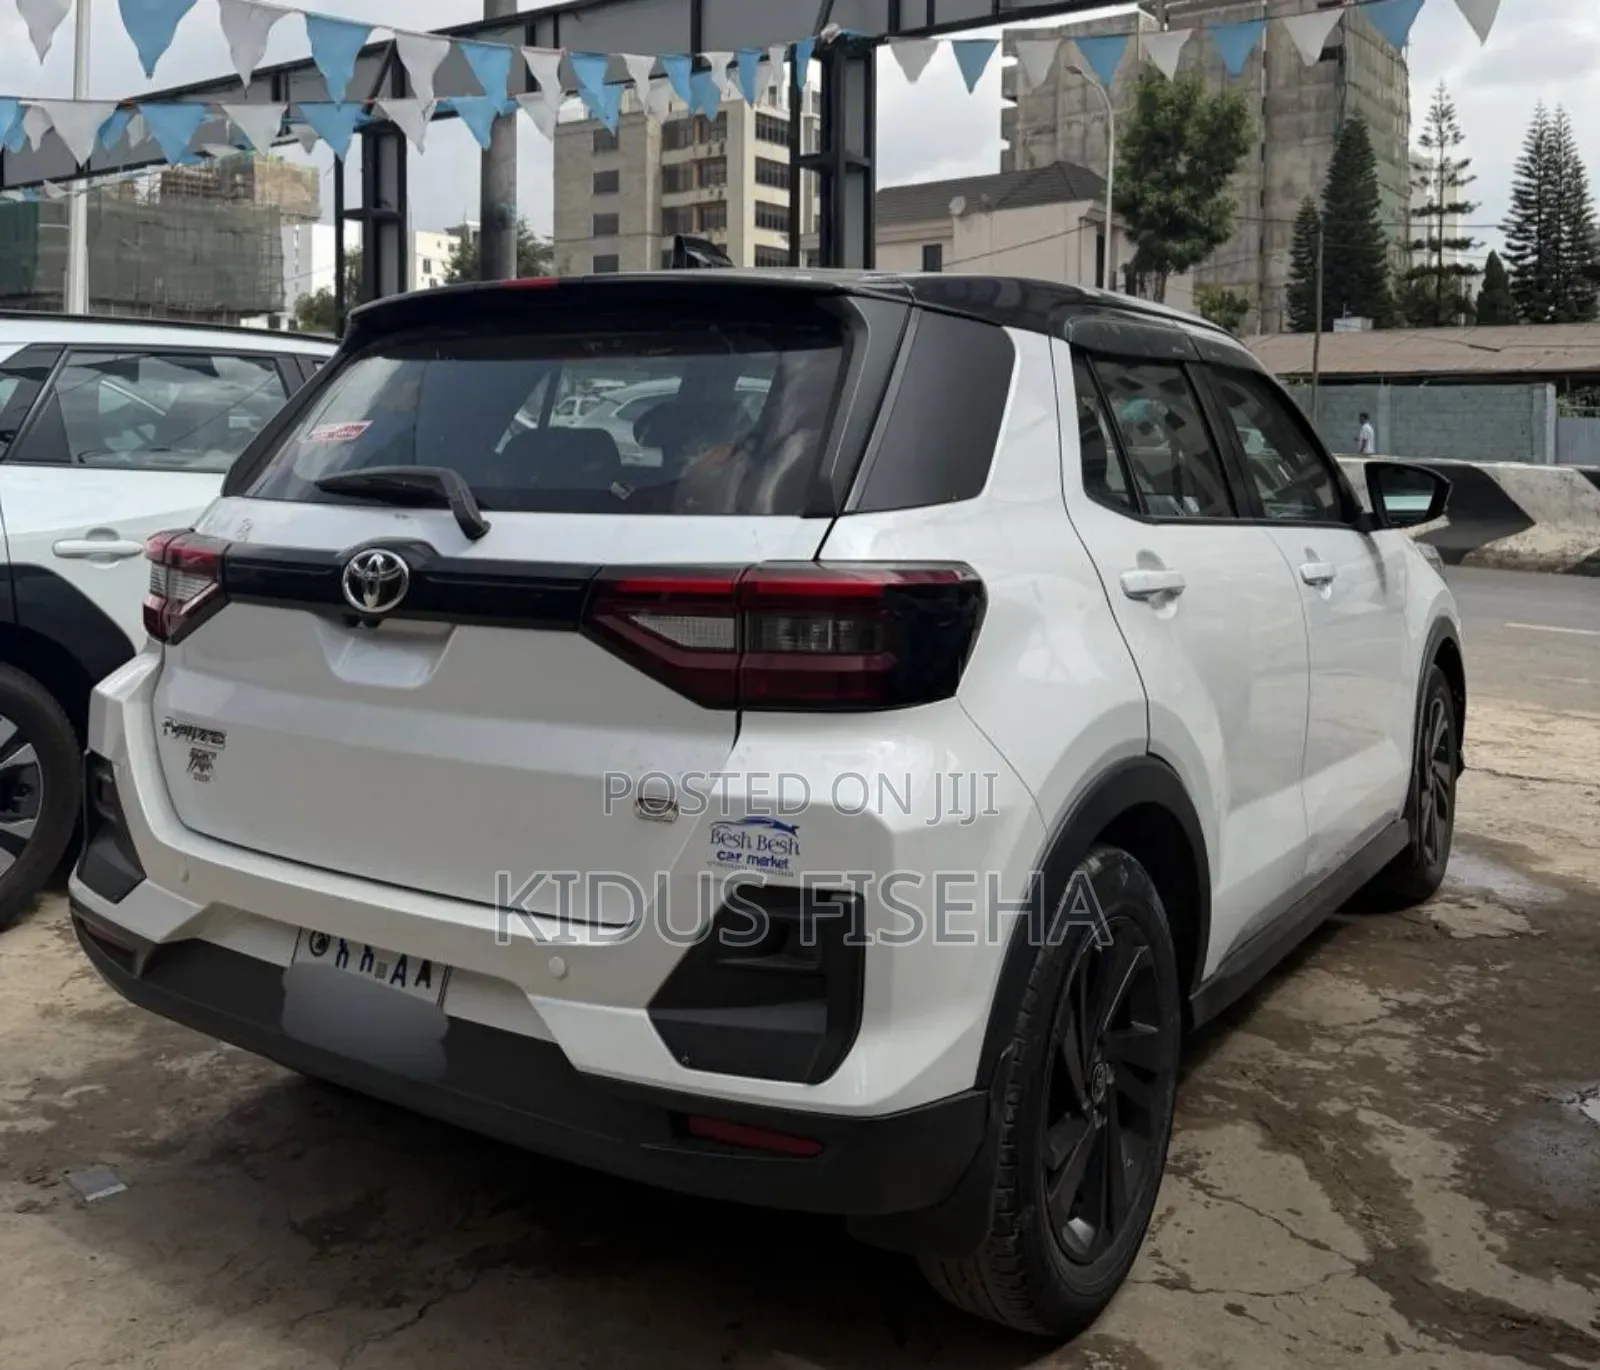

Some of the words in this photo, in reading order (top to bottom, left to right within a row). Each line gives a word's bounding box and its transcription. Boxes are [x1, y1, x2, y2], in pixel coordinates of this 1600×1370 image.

[709, 826, 752, 849] Besh
[756, 833, 800, 856] Besh
[716, 850, 742, 862] car
[747, 854, 789, 869] market
[389, 953, 432, 988] AA
